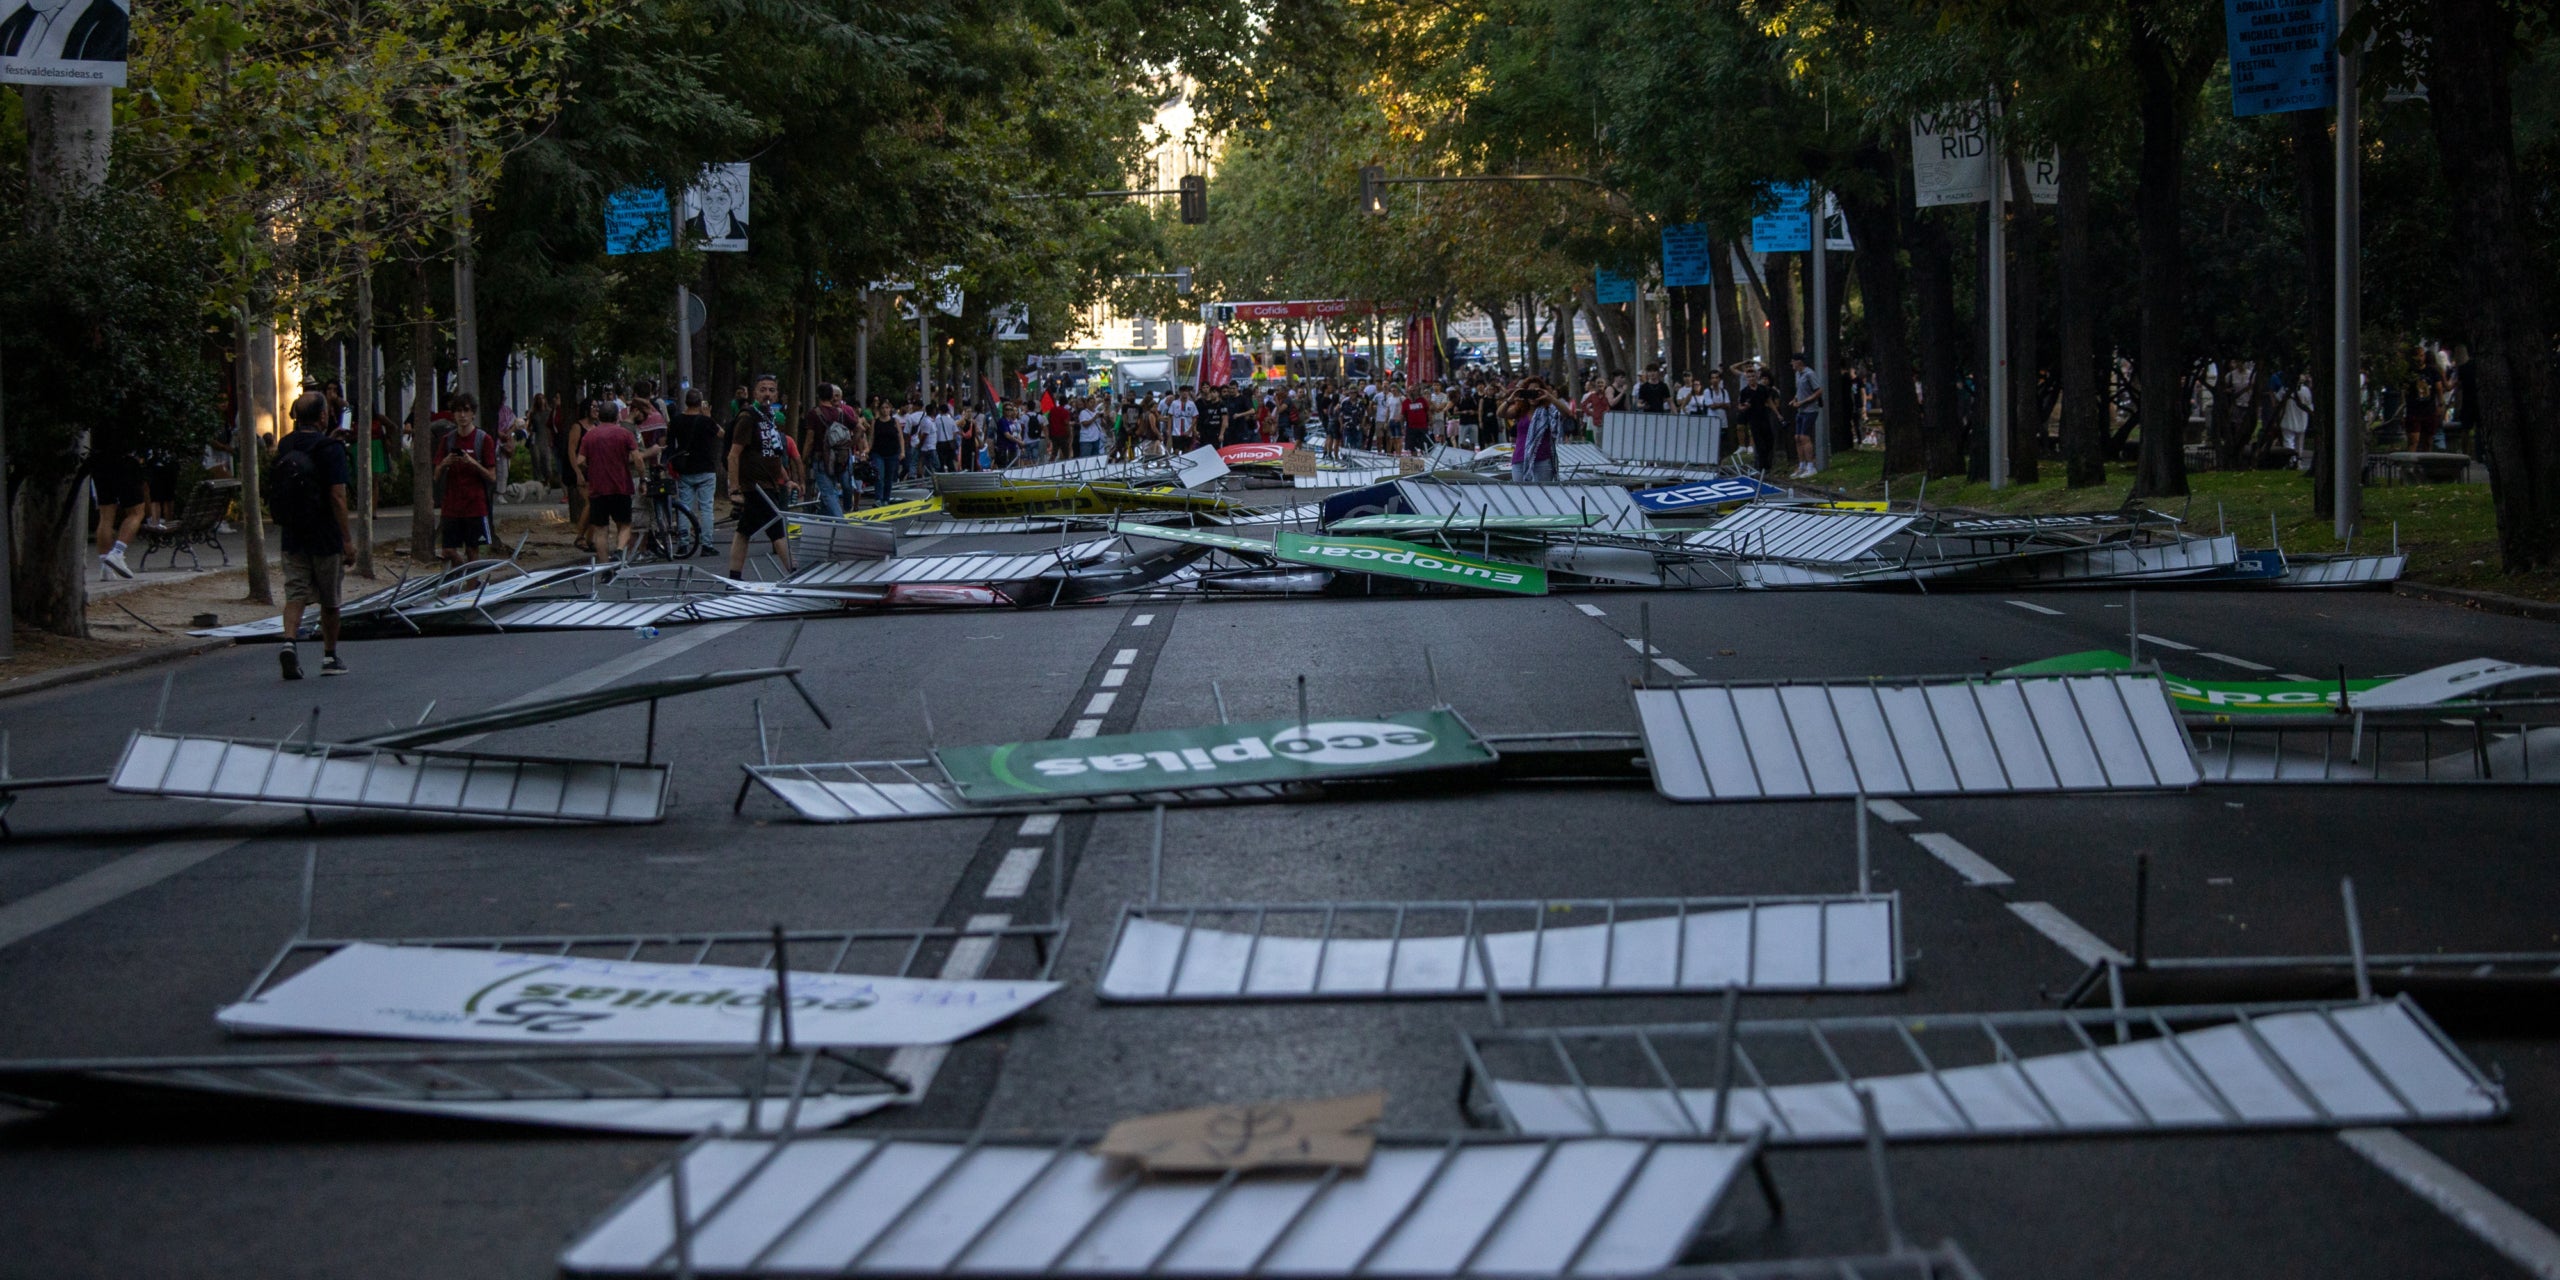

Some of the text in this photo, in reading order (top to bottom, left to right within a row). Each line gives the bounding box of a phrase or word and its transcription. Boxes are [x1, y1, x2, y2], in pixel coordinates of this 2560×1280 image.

[2239, 28, 2280, 42] MICHAEL
[5, 64, 104, 80] festivaldelasideas.es
[2236, 58, 2277, 72] FESTIVAL
[1941, 133, 1984, 159] RID
[1254, 306, 1289, 316] Cofidis
[1316, 303, 1346, 313] Cofidi
[1642, 480, 1755, 505] SER
[1298, 545, 1524, 585] Europcar
[1032, 730, 1437, 777] ecopilas
[472, 999, 614, 1034] 25
